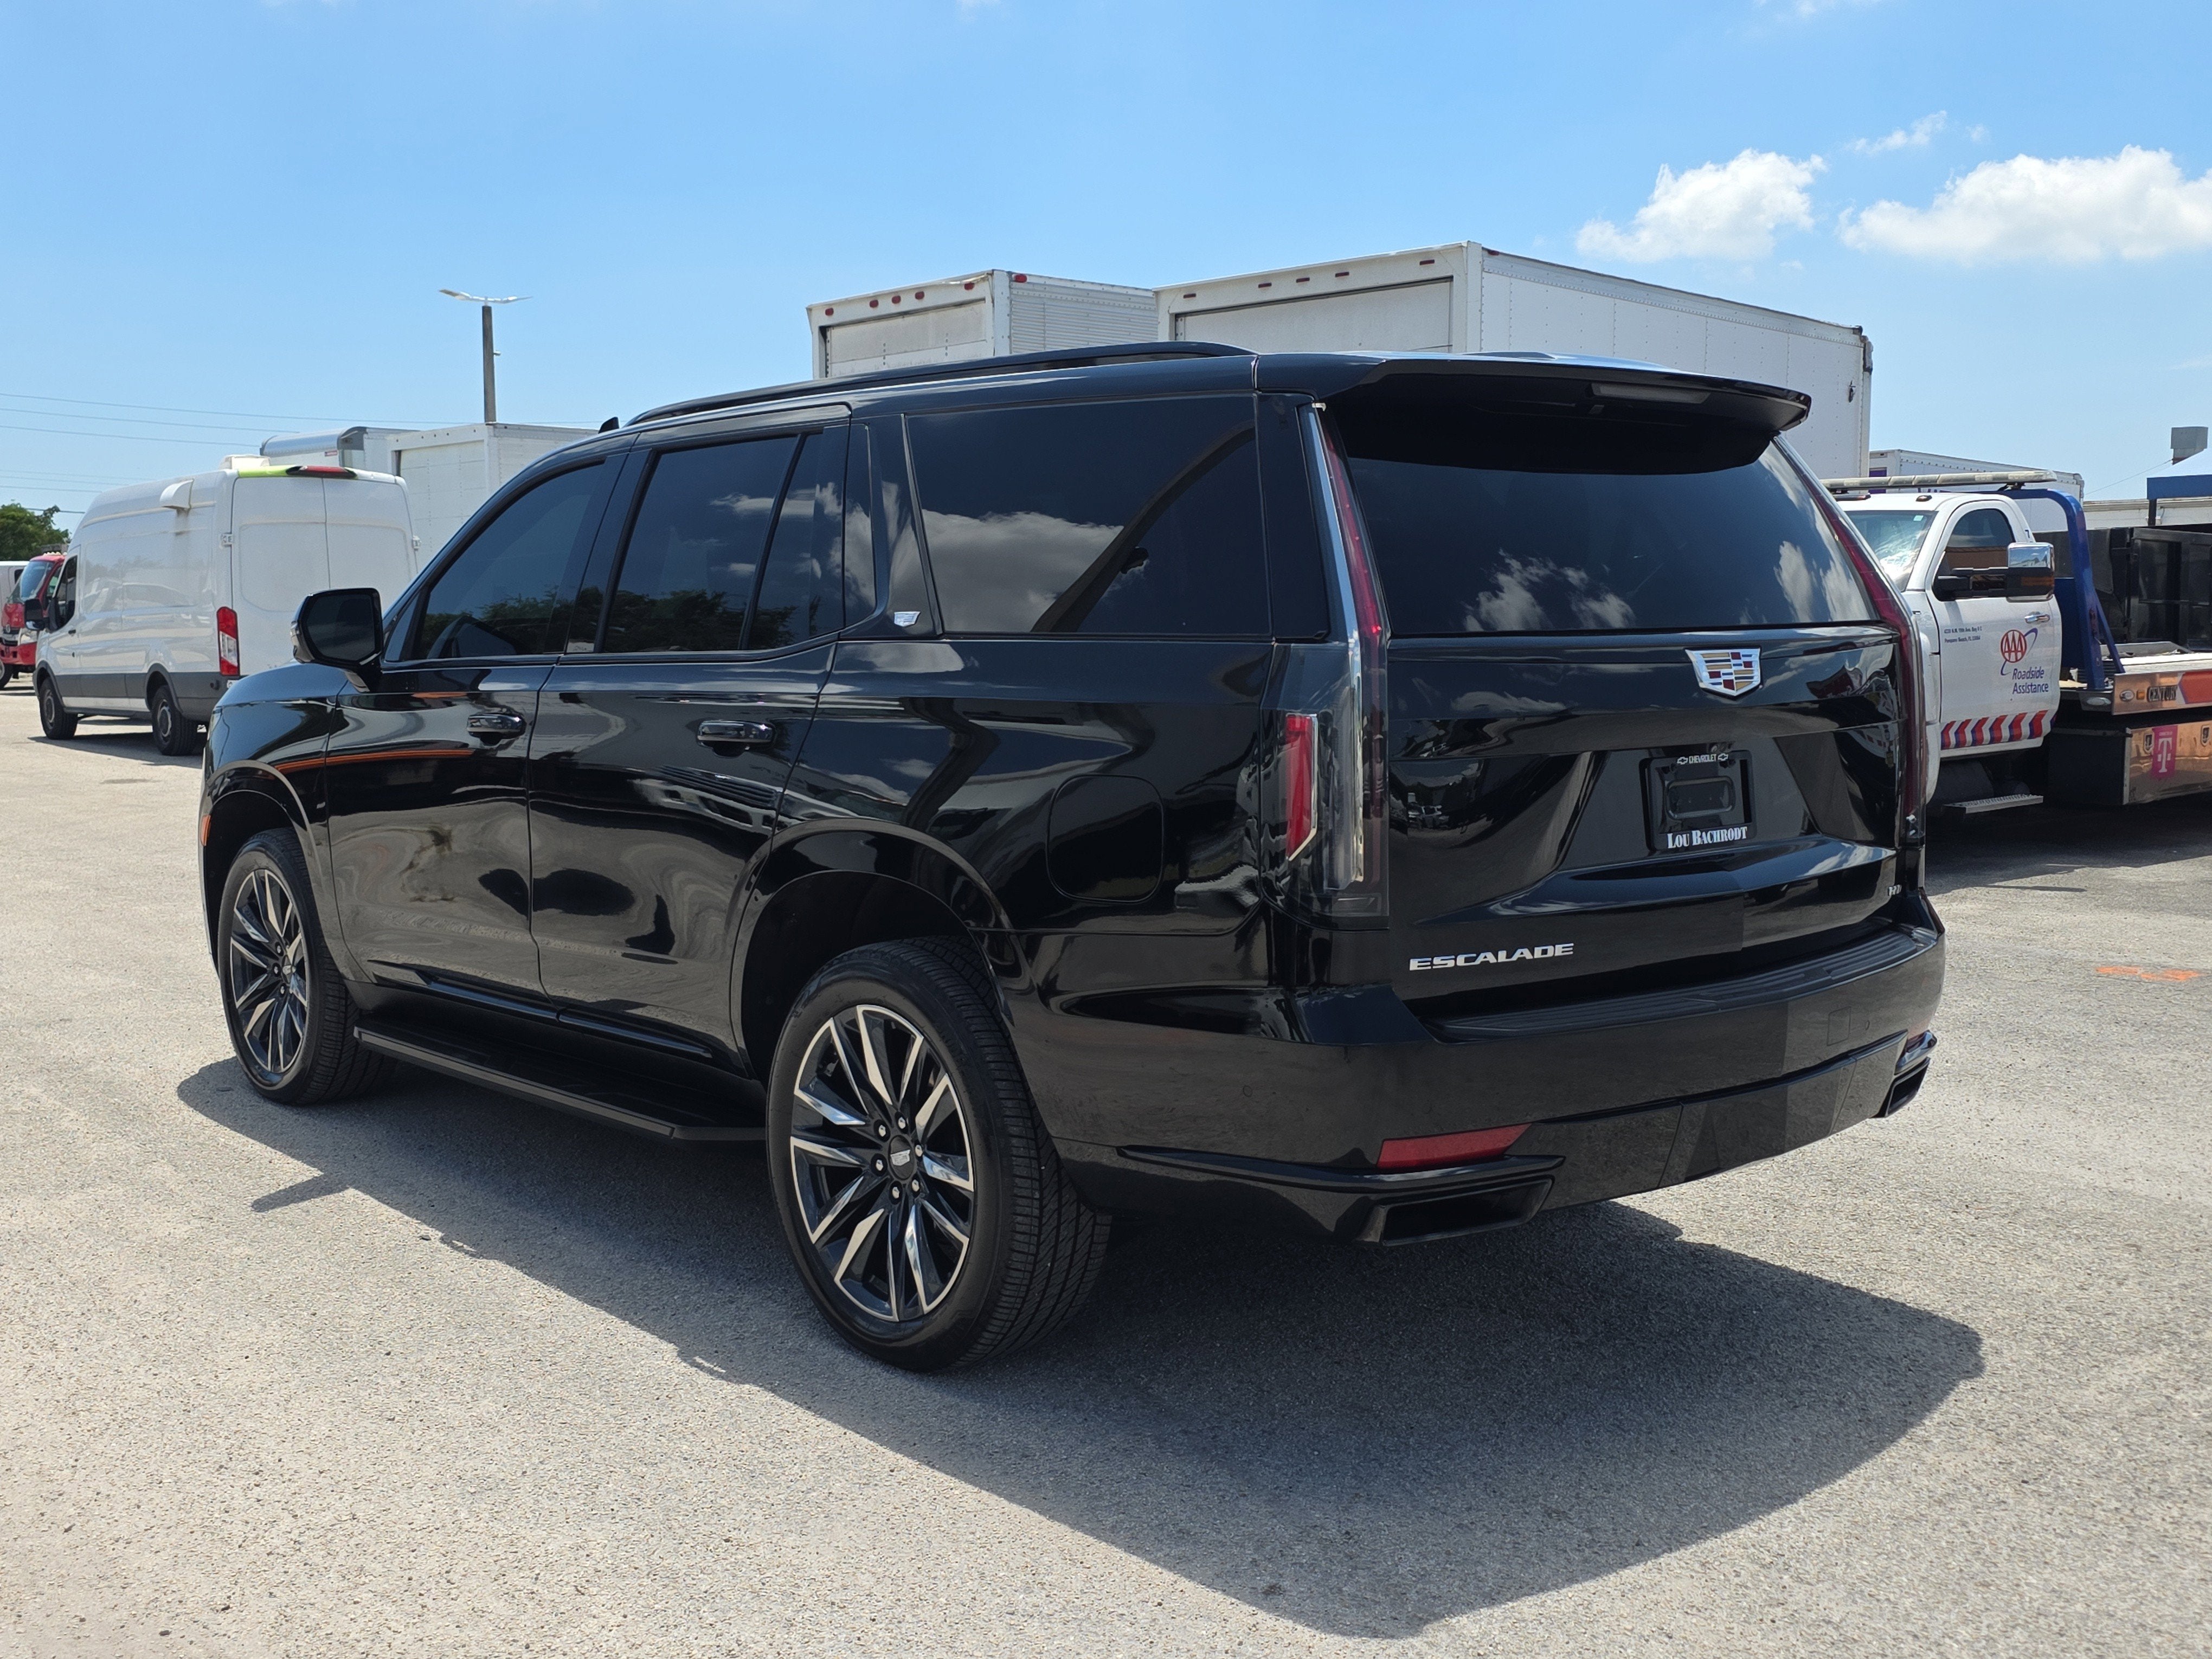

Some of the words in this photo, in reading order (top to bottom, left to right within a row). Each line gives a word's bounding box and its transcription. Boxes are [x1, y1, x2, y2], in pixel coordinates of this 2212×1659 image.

[2001, 629, 2027, 663] AAA
[2012, 666, 2044, 680] Roadside
[2012, 682, 2049, 695] Assistance
[1689, 754, 1717, 764] CHEVROLET
[2157, 737, 2172, 773] T
[1667, 833, 1690, 849] LOU
[1692, 826, 1748, 846] BACHRODT
[1410, 943, 1574, 971] ESCALADE
